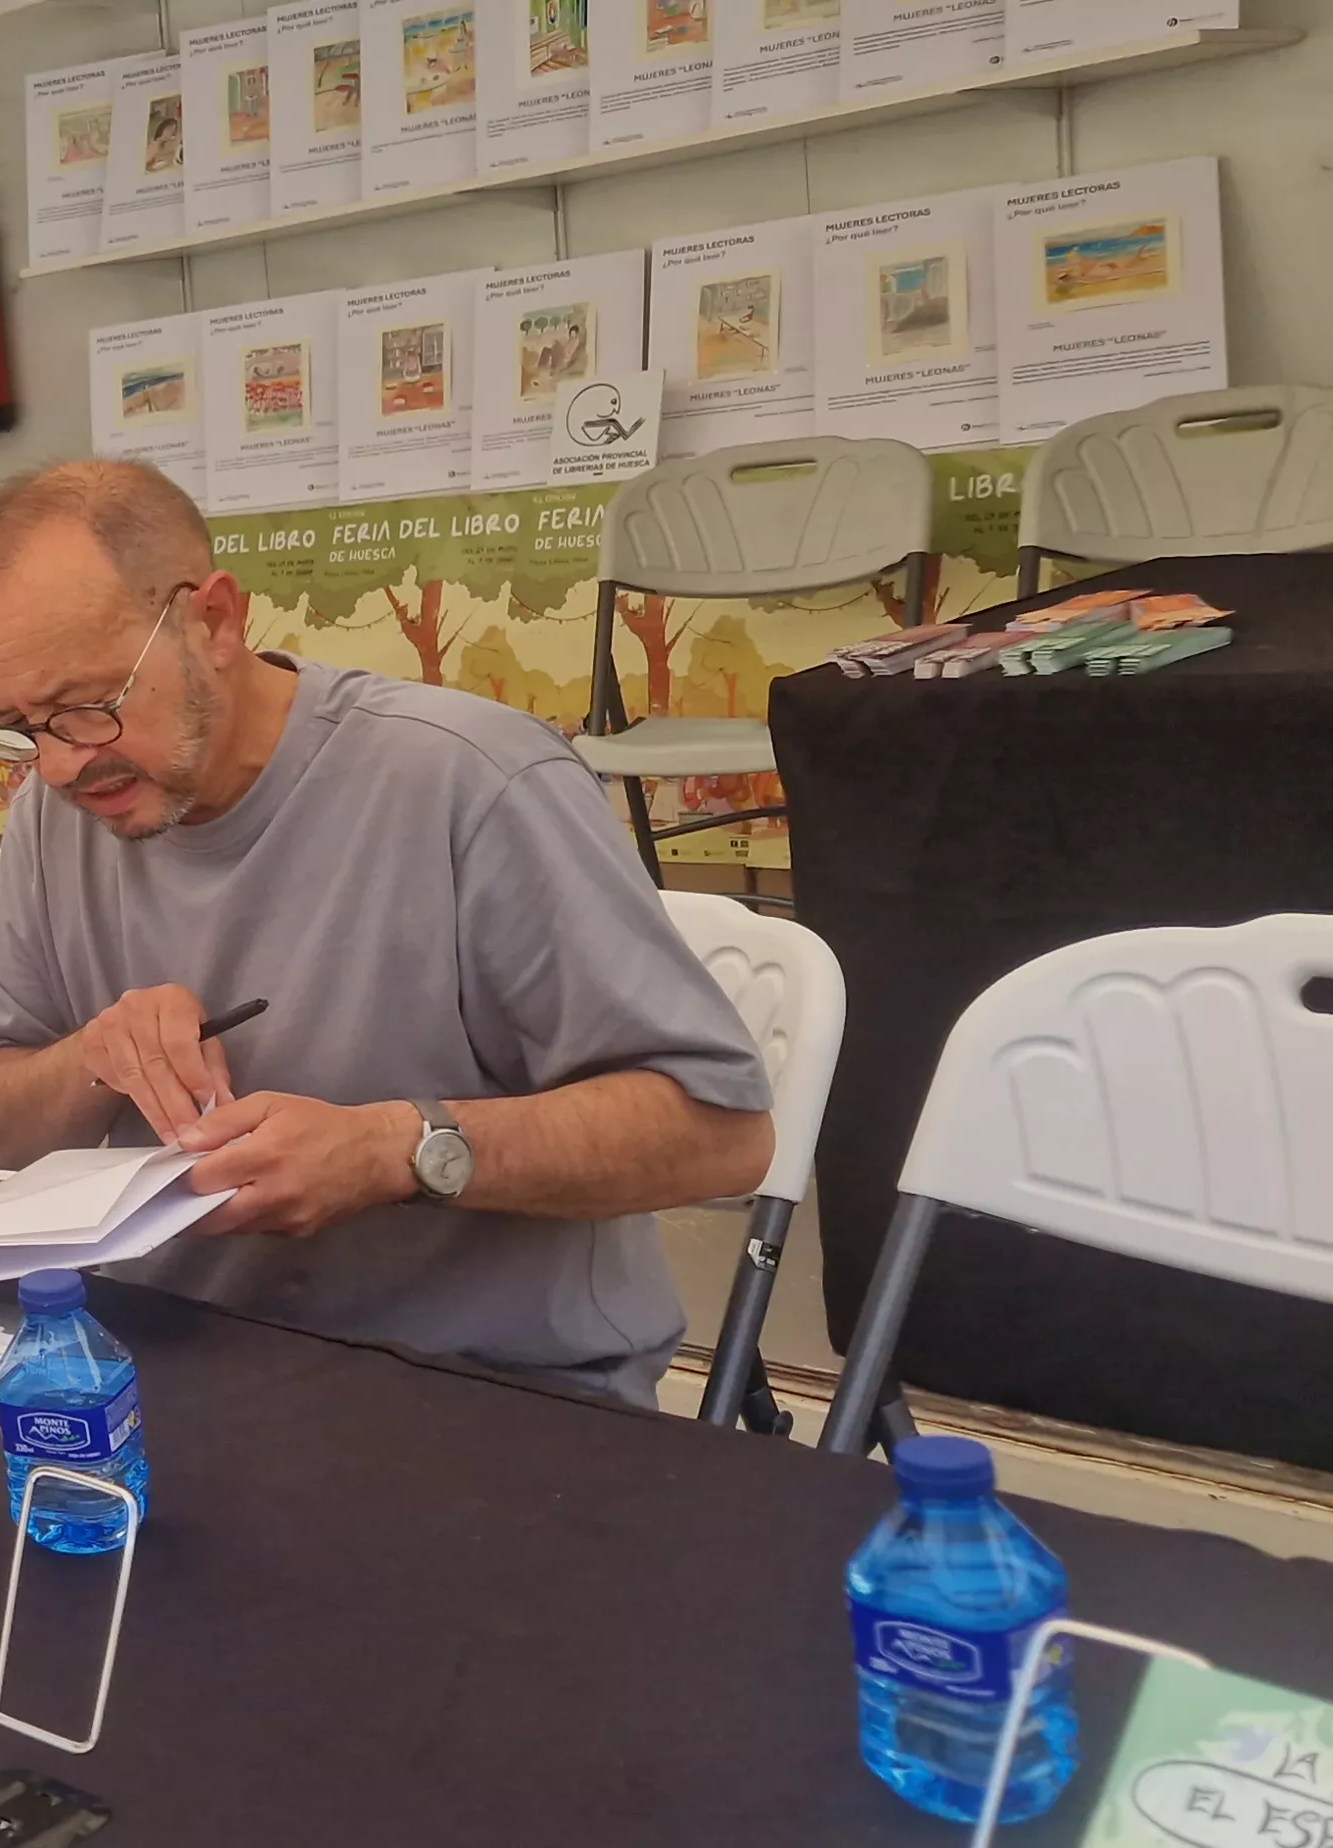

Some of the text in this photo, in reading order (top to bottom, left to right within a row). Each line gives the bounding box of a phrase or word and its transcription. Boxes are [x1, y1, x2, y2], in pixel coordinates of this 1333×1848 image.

[892, 6, 944, 22] MUJERES
[759, 36, 805, 53] MUJERES
[633, 68, 678, 82] MUJERES
[517, 94, 561, 108] MUJERES
[1007, 180, 1121, 207] MUJERES LECTORAS
[825, 206, 932, 234] MUJERES LECTORAS
[662, 234, 756, 258] MUJERES LECTORAS
[485, 269, 572, 291] MUJERES LECTORAS
[346, 287, 428, 308] MUJERES LECTORAS
[1052, 338, 1106, 353] MUJERES
[865, 371, 915, 386] MUJERES
[689, 389, 732, 403] MUJERES
[512, 413, 552, 425] MUJERES
[553, 449, 648, 465] ASOCIACIÓN PROVINCIAL
[552, 466, 563, 475] DE
[605, 462, 617, 470] DE
[617, 459, 651, 469] HUESCA
[950, 472, 1017, 501] LIBR
[331, 512, 521, 546] FERIA DEL LIBRO
[213, 528, 317, 556] DEL LIBRO
[534, 536, 554, 551] DE
[328, 546, 398, 563] DE HUESCA
[33, 1416, 70, 1428] MONTE
[39, 1425, 71, 1436] PINOS
[1272, 1741, 1319, 1785] LA
[1186, 1784, 1237, 1822] EL
